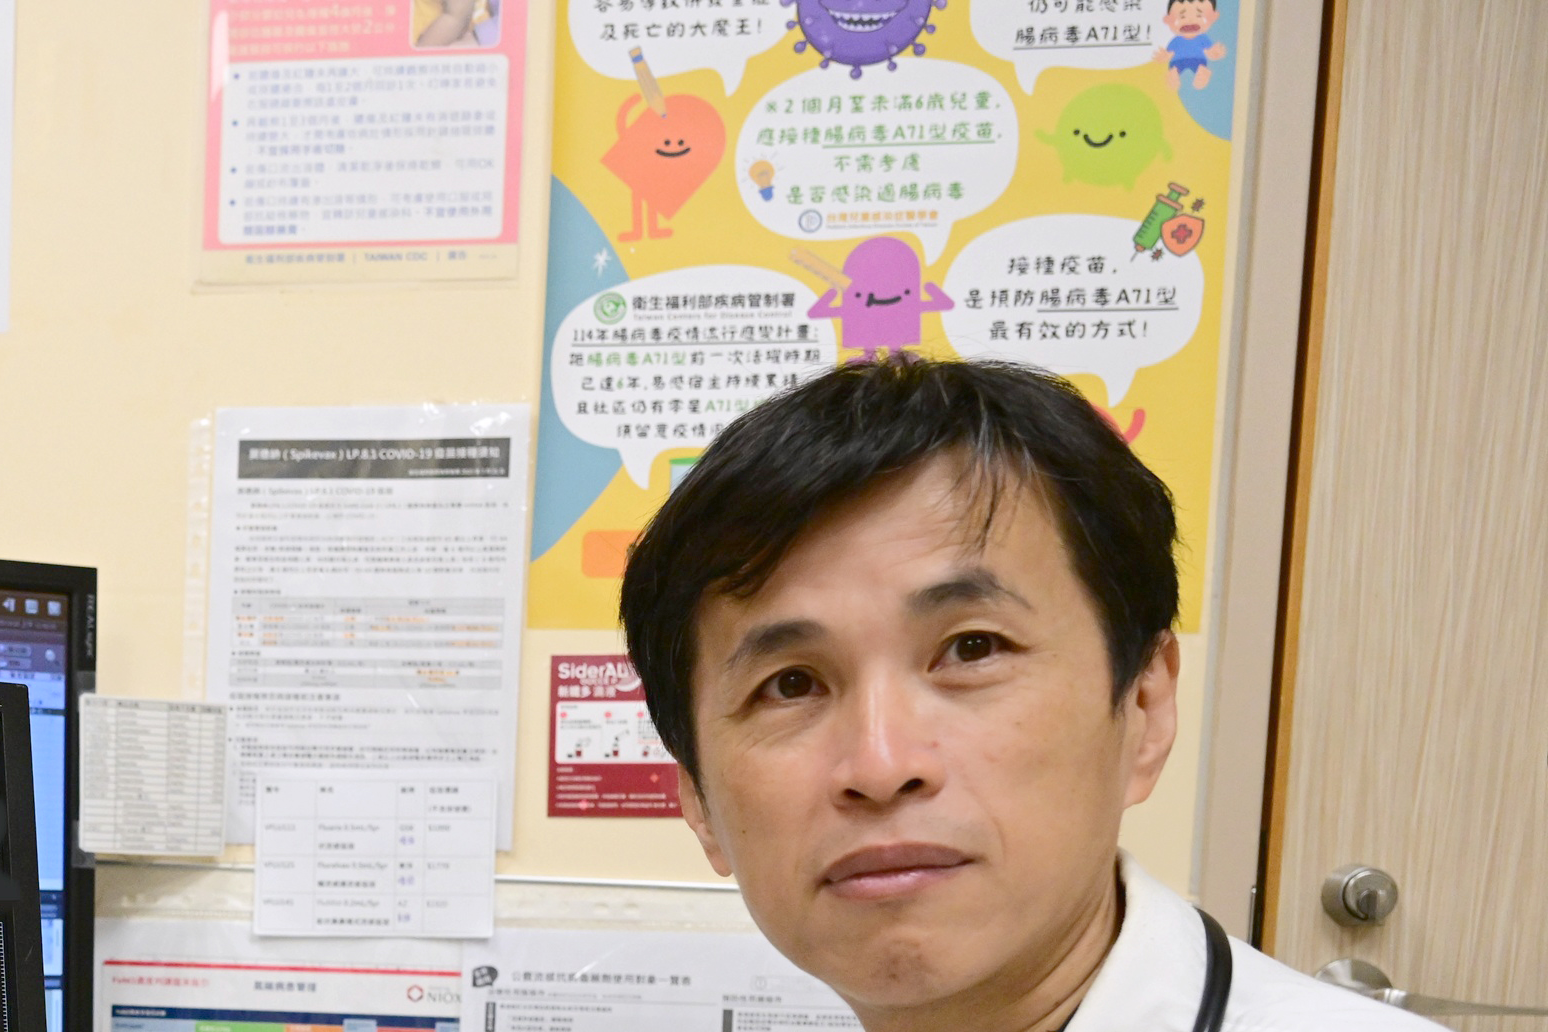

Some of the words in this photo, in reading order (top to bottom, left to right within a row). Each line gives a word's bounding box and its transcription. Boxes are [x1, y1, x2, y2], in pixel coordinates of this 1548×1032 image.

[833, 152, 922, 173] 不需考慮
[785, 182, 965, 206] 是否感染過腸病毒
[632, 292, 796, 311] 衛生福利部疾病管制署
[963, 286, 1178, 309] 是預防腸病毒A71型
[989, 320, 1150, 340] 最有效的方式！
